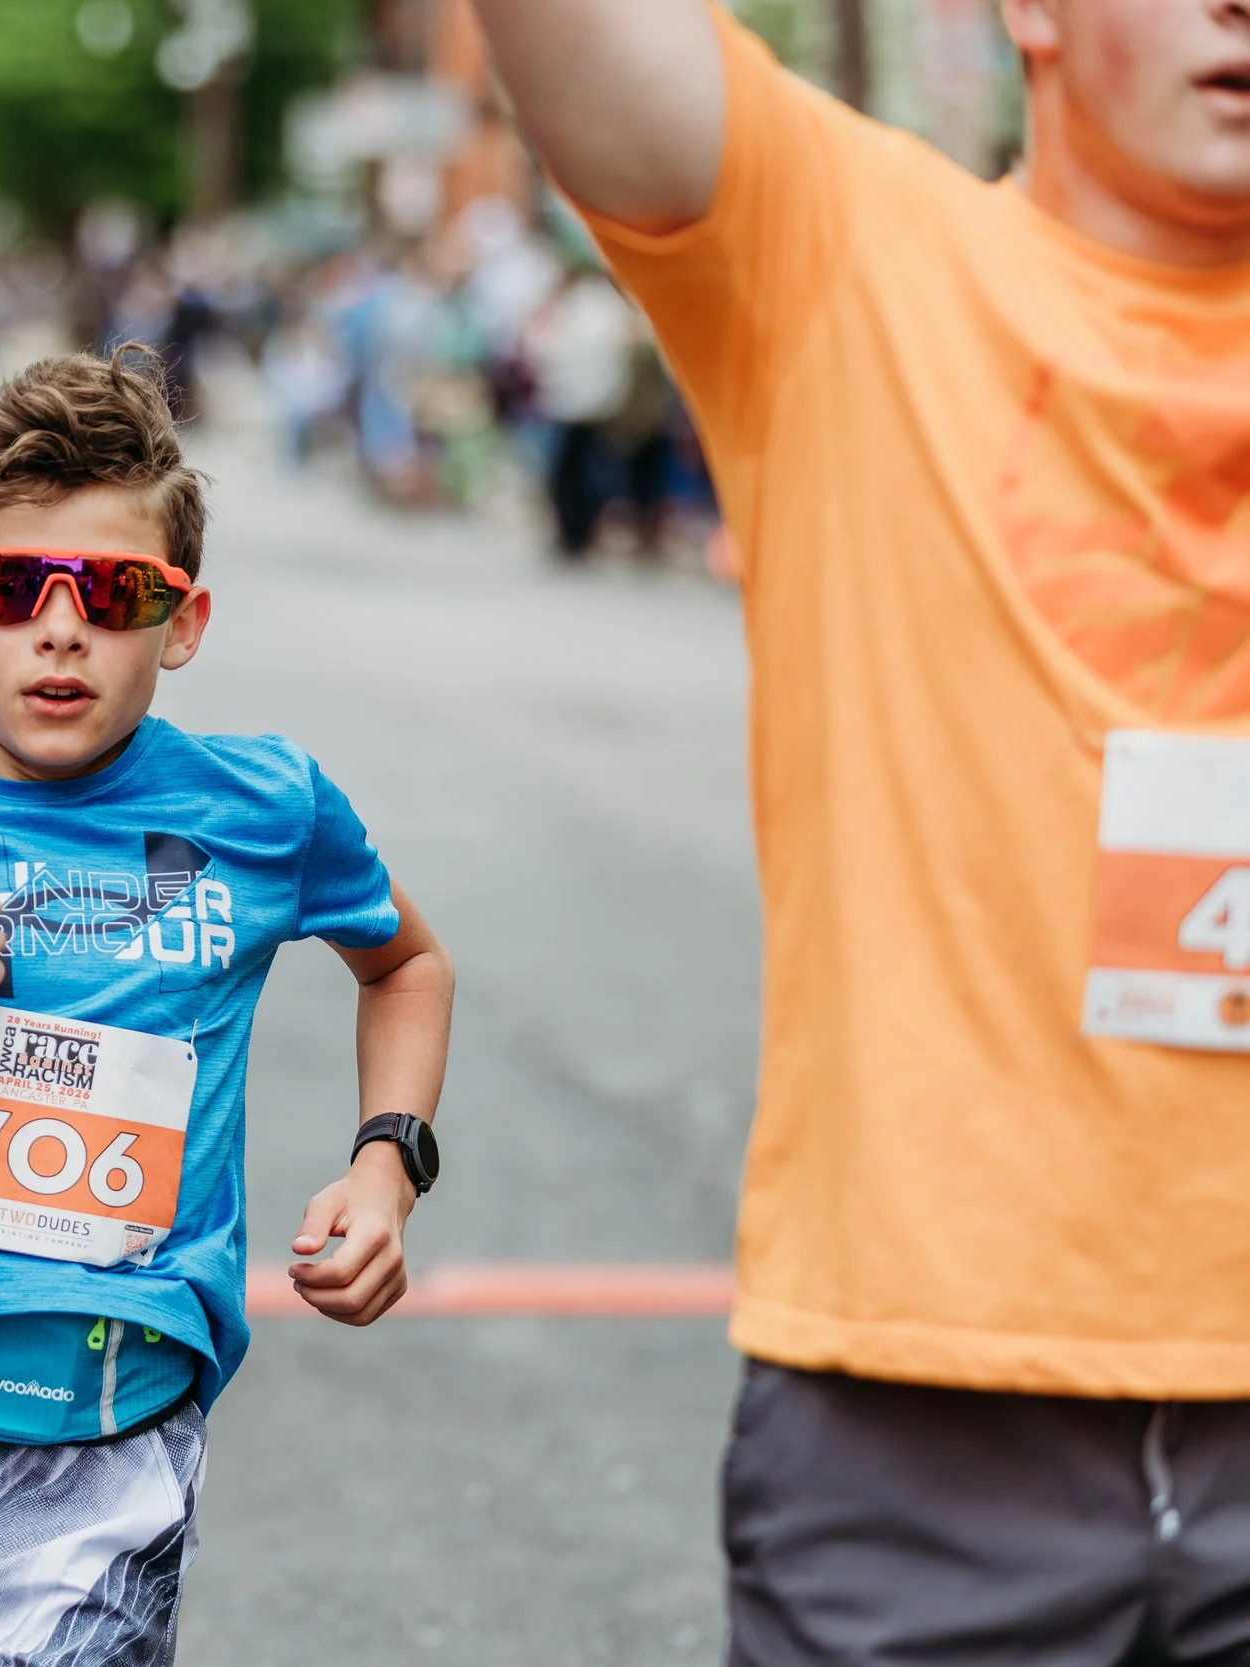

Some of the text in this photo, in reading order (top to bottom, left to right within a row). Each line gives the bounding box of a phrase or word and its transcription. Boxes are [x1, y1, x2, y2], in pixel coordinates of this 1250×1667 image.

[1177, 866, 1250, 970] 4
[6, 1015, 102, 1040] 28 Years Running!
[17, 1031, 100, 1067] race
[12, 1062, 93, 1091] RACISM
[17, 1053, 93, 1077] against
[36, 1082, 55, 1094] 25,
[59, 1087, 90, 1100] 2026
[73, 1098, 88, 1109] PA
